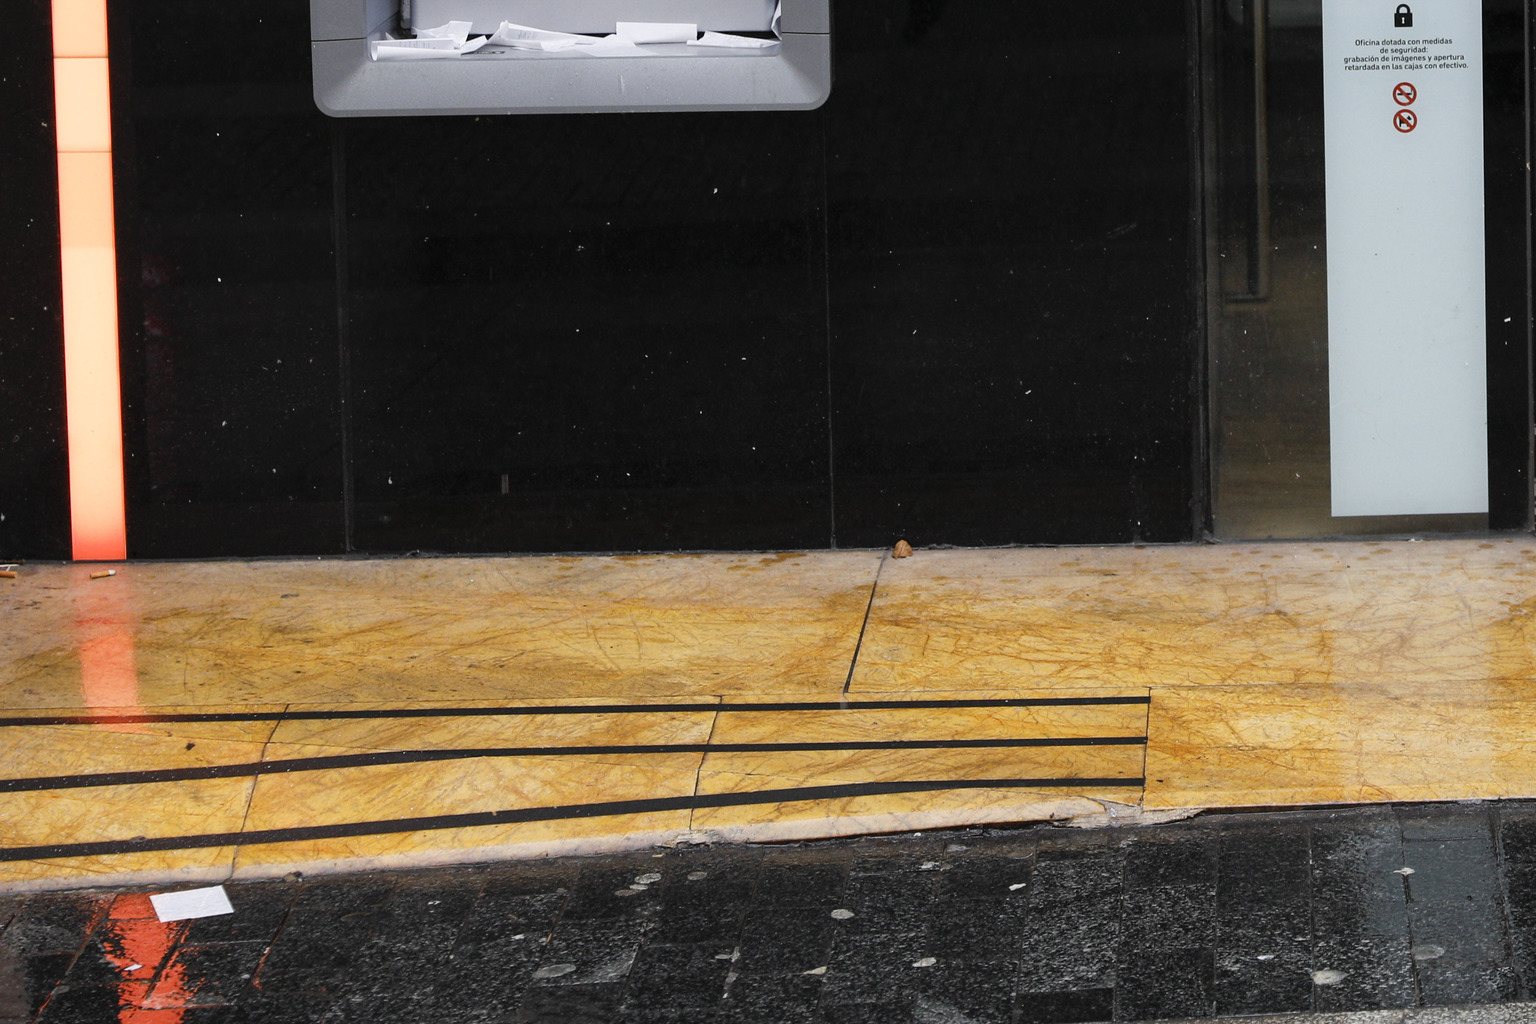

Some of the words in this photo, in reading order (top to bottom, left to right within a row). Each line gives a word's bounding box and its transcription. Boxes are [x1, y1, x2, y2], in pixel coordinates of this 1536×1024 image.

[1381, 38, 1406, 46] dotada
[1390, 46, 1428, 55] seguridad:
[1343, 56, 1379, 64] grabación
[1380, 54, 1390, 62] de
[1391, 53, 1426, 63] imágenes
[1433, 54, 1465, 63] apertura
[1344, 63, 1380, 71] retardada
[1404, 61, 1423, 71] cajas
[1439, 61, 1468, 69] efectivo.
